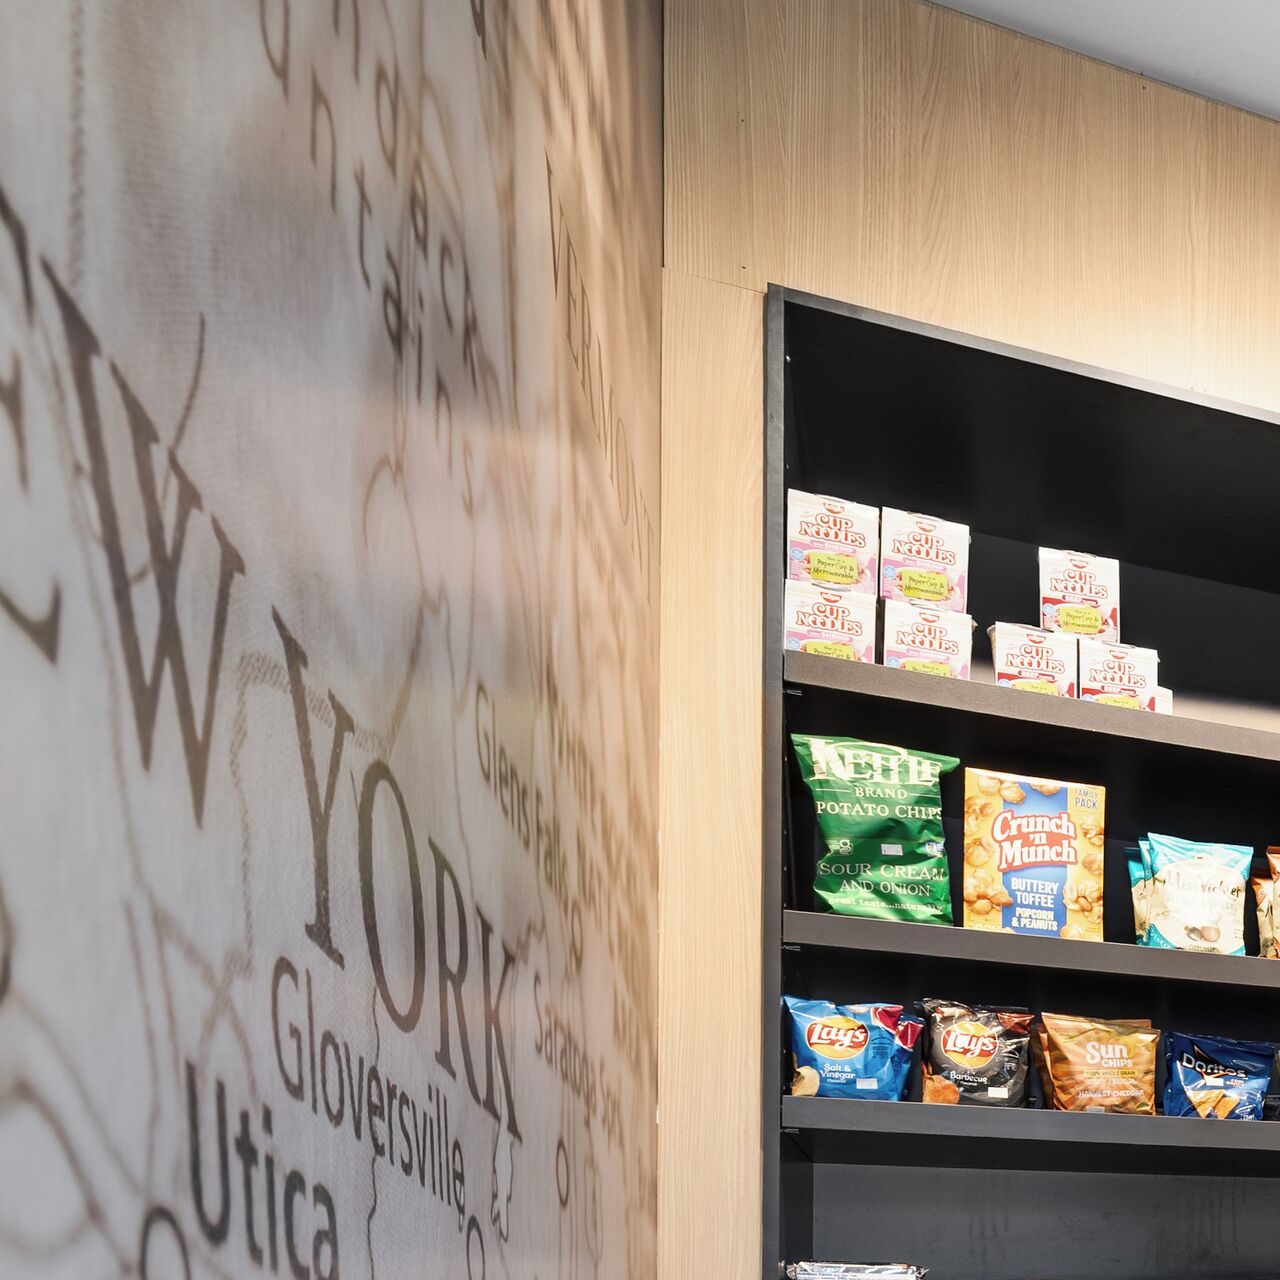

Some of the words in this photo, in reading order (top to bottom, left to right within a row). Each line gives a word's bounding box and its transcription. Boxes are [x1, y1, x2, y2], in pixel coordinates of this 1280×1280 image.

[545, 149, 654, 607] VERMONT
[815, 513, 853, 530] CUP
[799, 521, 866, 548] NOODLES
[908, 531, 944, 548] CUP
[892, 539, 957, 565] NOODLES
[1063, 569, 1096, 585] CUP
[1050, 578, 1108, 599] NOODLES
[812, 602, 850, 619] CUP
[796, 611, 862, 636] NOODLES
[911, 622, 948, 639] CUP
[896, 631, 959, 655] NOODLES
[1019, 644, 1053, 660] CUP
[1006, 653, 1065, 674] NOODLES
[1103, 660, 1135, 675] CUP
[1089, 669, 1146, 688] NOODLES
[475, 678, 530, 851] Glens
[855, 787, 908, 800] BRAND
[1075, 788, 1098, 799] FAMILY
[816, 801, 890, 817] POTATO
[895, 805, 942, 820] CHIPS
[1075, 797, 1097, 810] PACK
[993, 811, 1076, 842] Crunch
[999, 839, 1077, 871] Munch
[271, 603, 522, 1144] YORK
[819, 863, 873, 876] SOUR
[880, 864, 945, 881] CREAM
[840, 880, 874, 892] AND
[880, 881, 931, 897] ONION
[1010, 877, 1060, 895] BUTTERY
[1016, 891, 1055, 908] TOFFEE
[1015, 907, 1055, 921] POPCORN
[1011, 917, 1020, 927] &
[1021, 917, 1058, 931] PEANUTS
[808, 1022, 866, 1050] Lay's
[944, 1032, 997, 1058] Lay's
[533, 971, 597, 1128] Saratoga
[1085, 1041, 1128, 1065] Sun
[824, 1063, 842, 1073] Salt
[843, 1064, 851, 1073] &
[1101, 1057, 1133, 1068] CHIPS
[1182, 1052, 1248, 1079] Doritos
[820, 1070, 856, 1081] Vinegar
[950, 1069, 988, 1084] Barbecue
[271, 956, 465, 1219] Gloversville
[1078, 1089, 1111, 1098] HARVEST
[1111, 1089, 1144, 1098] CHEDDAR
